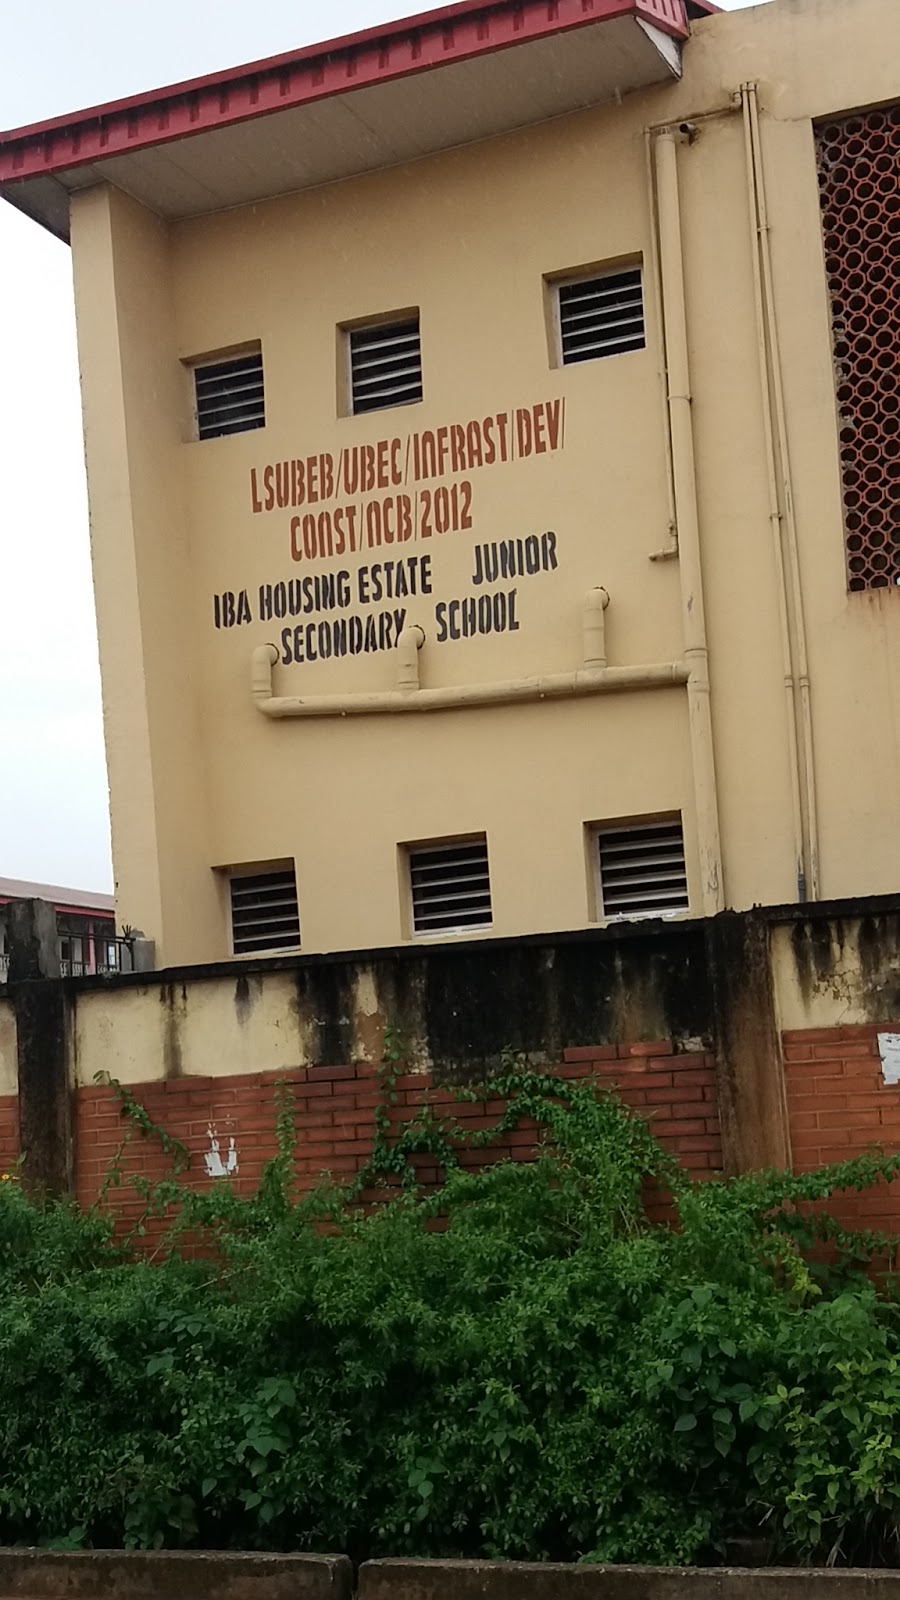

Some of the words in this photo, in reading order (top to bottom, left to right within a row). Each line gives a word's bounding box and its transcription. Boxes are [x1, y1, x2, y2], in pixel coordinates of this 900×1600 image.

[290, 481, 473, 562] CONST/NCB/2012
[213, 588, 252, 629] IBA
[258, 570, 351, 622] HOUSING
[357, 555, 432, 604] ESTATE
[472, 531, 558, 586] JUNIOR
[281, 608, 407, 666] SECONDARY
[435, 588, 520, 643] SCHOOL
